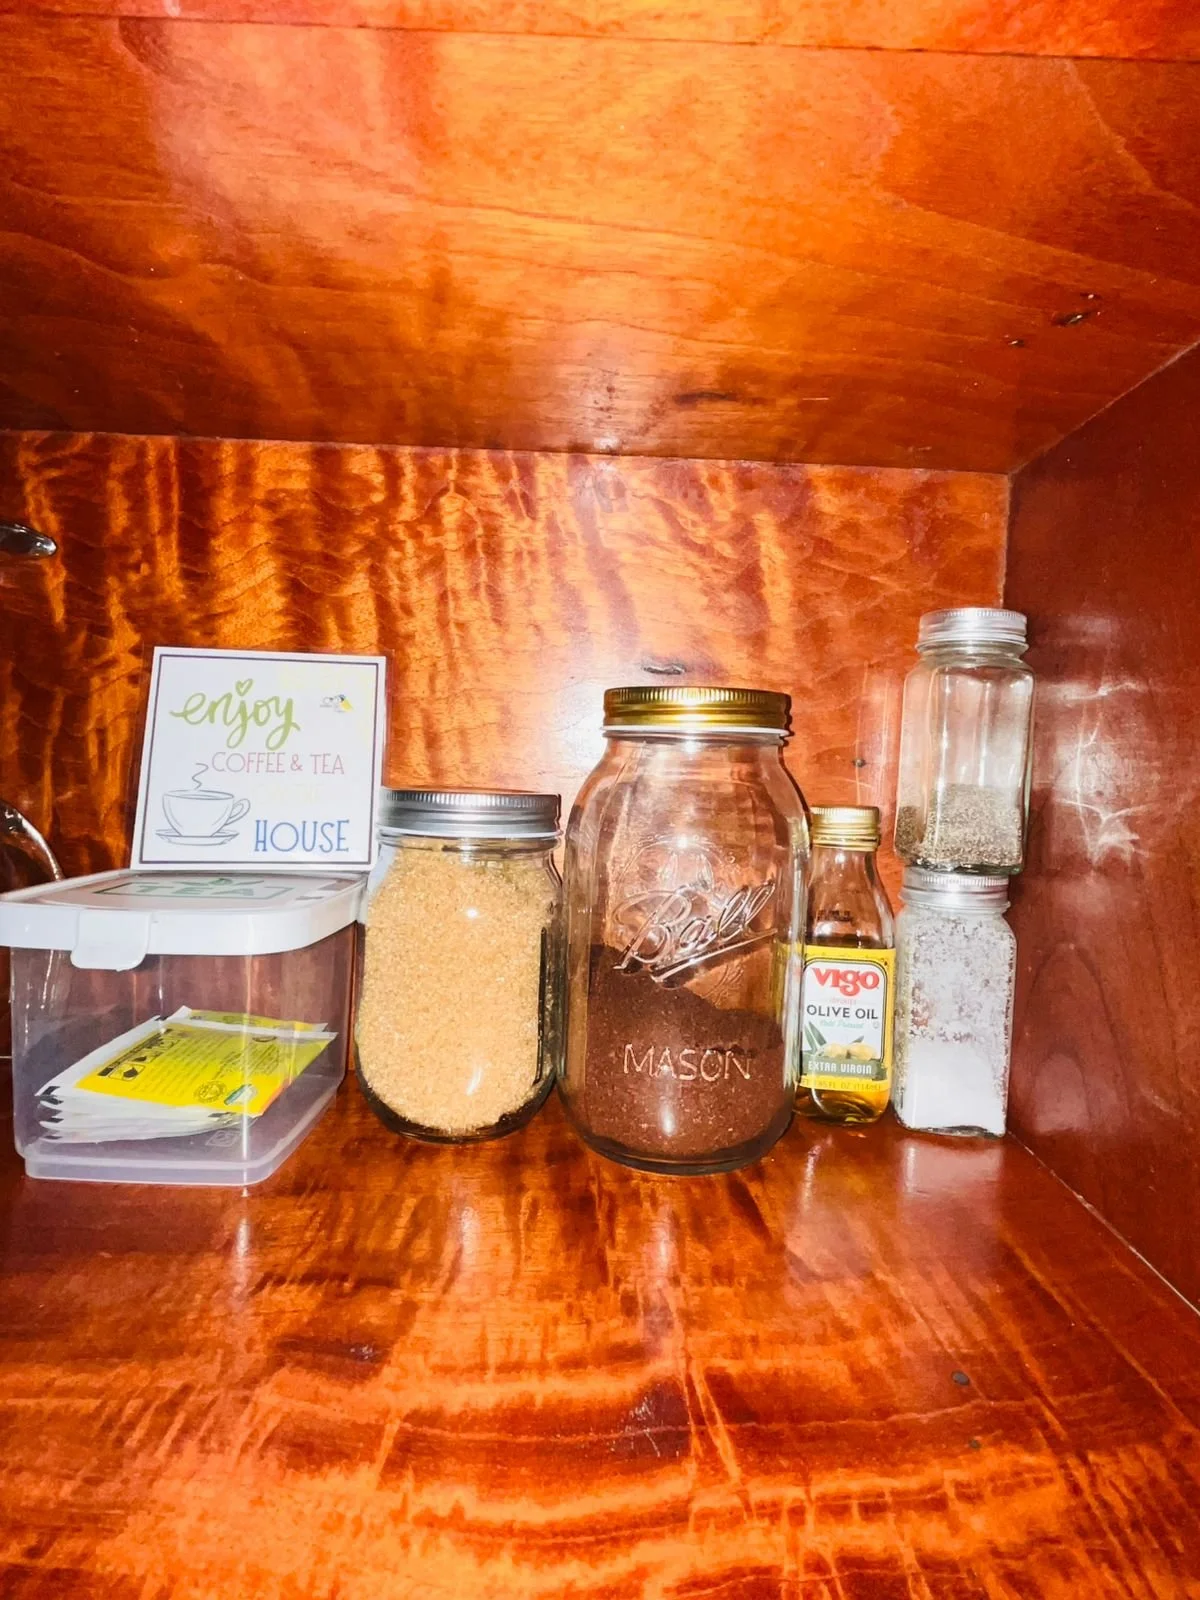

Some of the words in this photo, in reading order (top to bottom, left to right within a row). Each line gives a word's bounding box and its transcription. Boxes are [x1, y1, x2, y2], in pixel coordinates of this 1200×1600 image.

[169, 678, 301, 751] enjoy
[211, 752, 286, 774] COFFEE
[290, 756, 303, 772] &
[310, 753, 345, 775] TEA
[254, 819, 350, 853] HOUSE
[136, 885, 255, 897] TEA
[612, 878, 777, 976] Ball
[806, 1004, 850, 1018] OLIVE
[855, 1008, 879, 1020] OIL
[623, 1043, 751, 1082] MASON
[808, 1061, 837, 1073] EXTRA
[840, 1063, 873, 1075] VIRGIN
